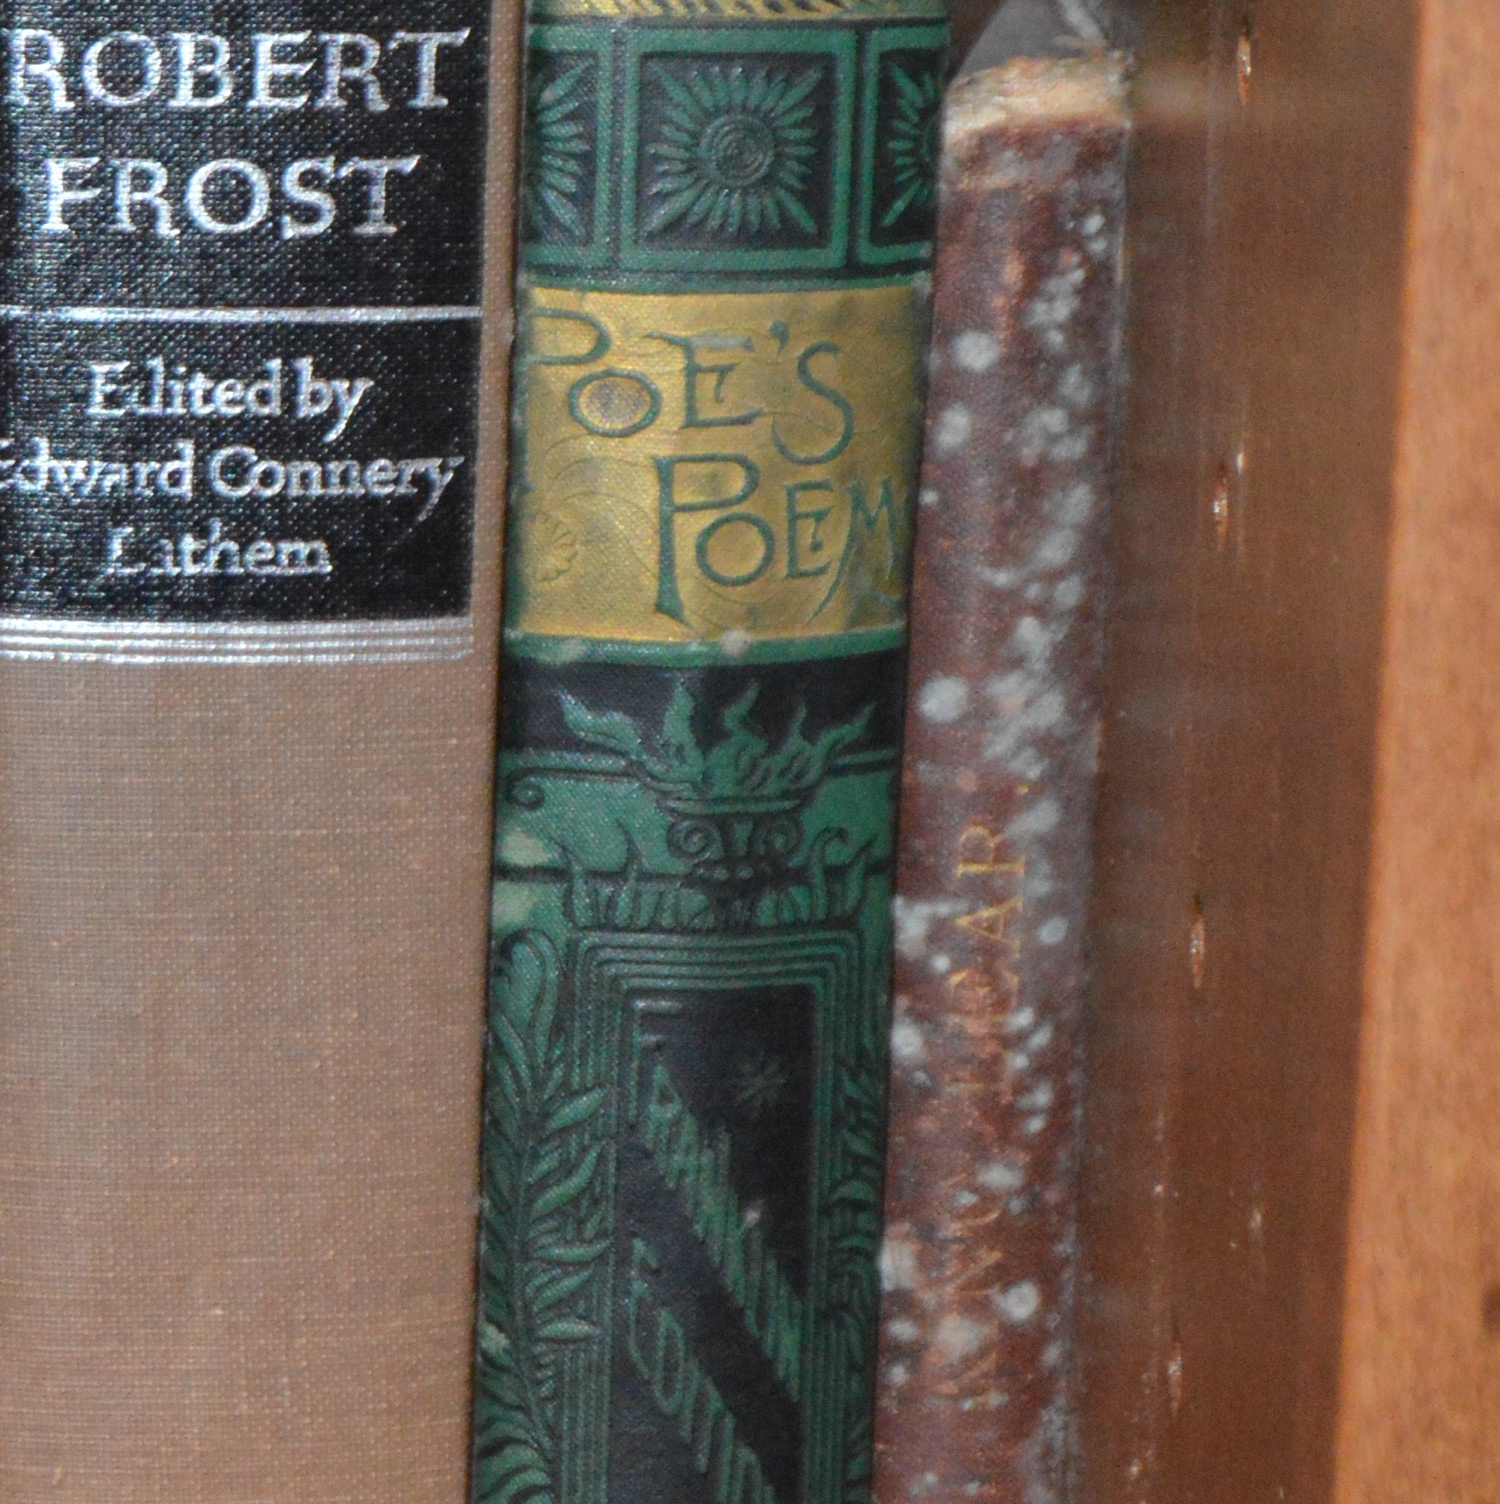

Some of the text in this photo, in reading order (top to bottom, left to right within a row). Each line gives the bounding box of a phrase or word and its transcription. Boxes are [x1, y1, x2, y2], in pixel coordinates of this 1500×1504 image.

[0, 26, 472, 113] ROBERT
[40, 154, 422, 240] FROST
[293, 355, 376, 443] by
[208, 443, 466, 523] Connery
